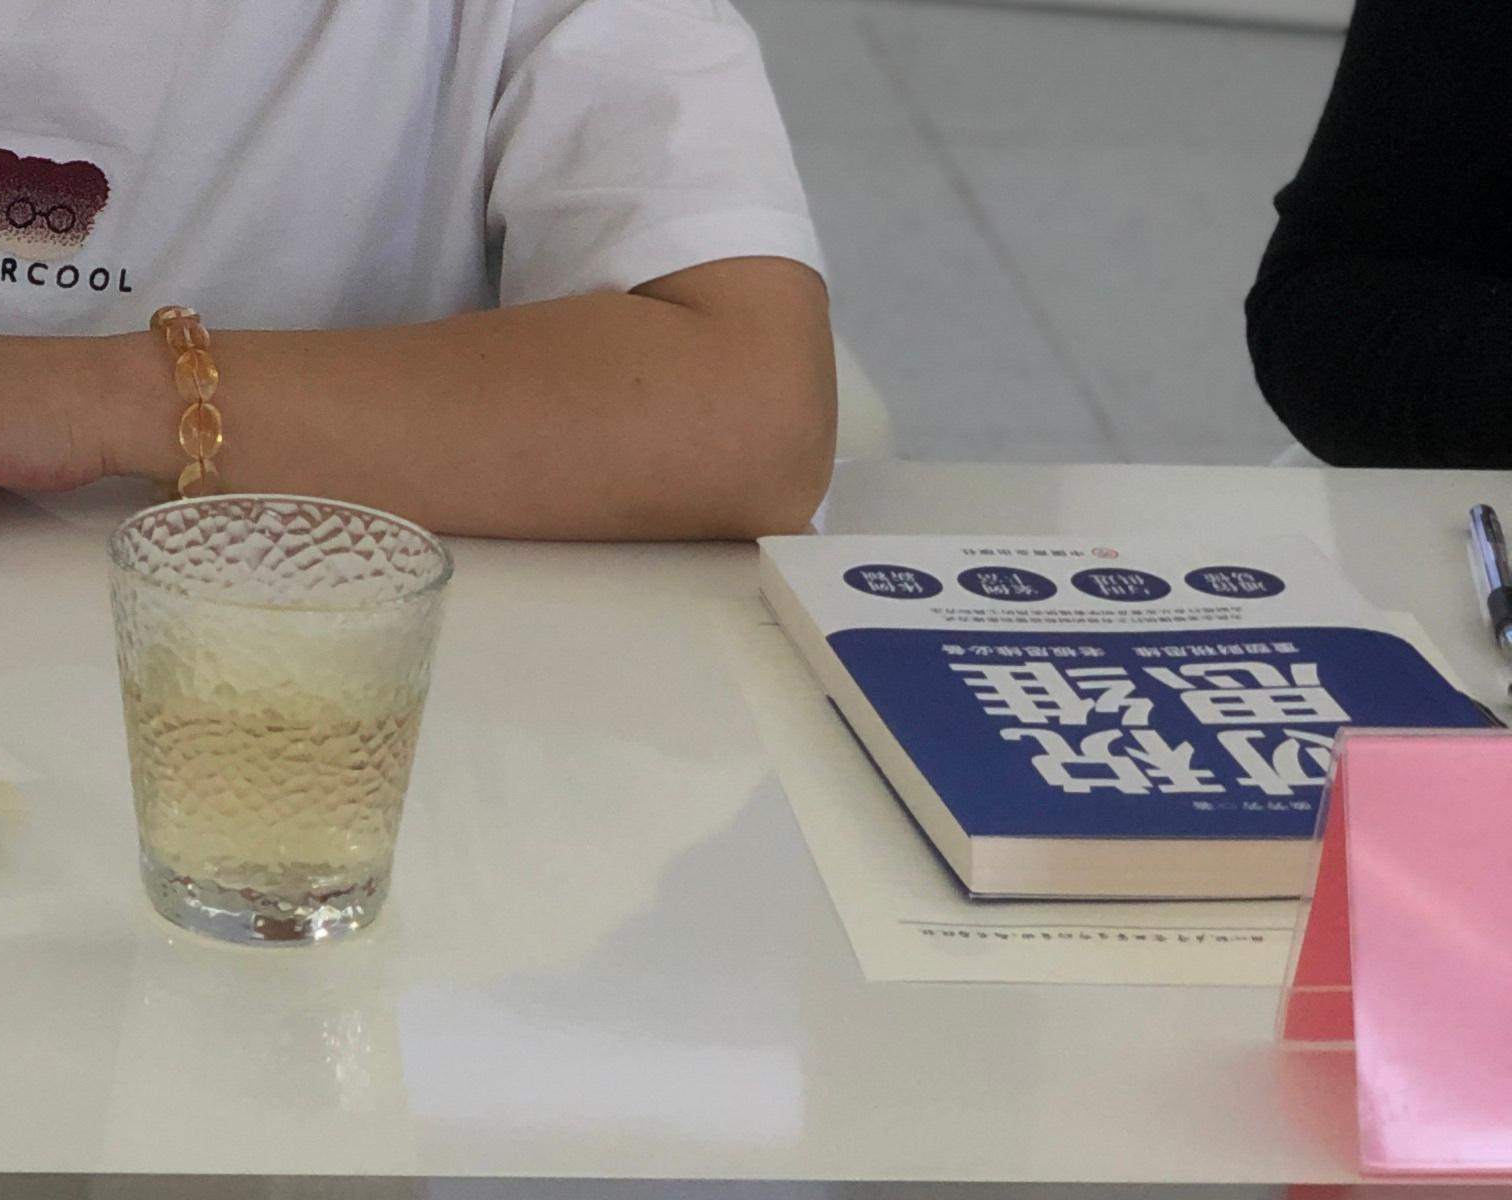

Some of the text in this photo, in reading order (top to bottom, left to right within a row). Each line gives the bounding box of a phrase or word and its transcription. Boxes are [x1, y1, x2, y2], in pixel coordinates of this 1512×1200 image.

[1132, 642, 1299, 657] 重塑财税思维
[949, 662, 1351, 725] 思维
